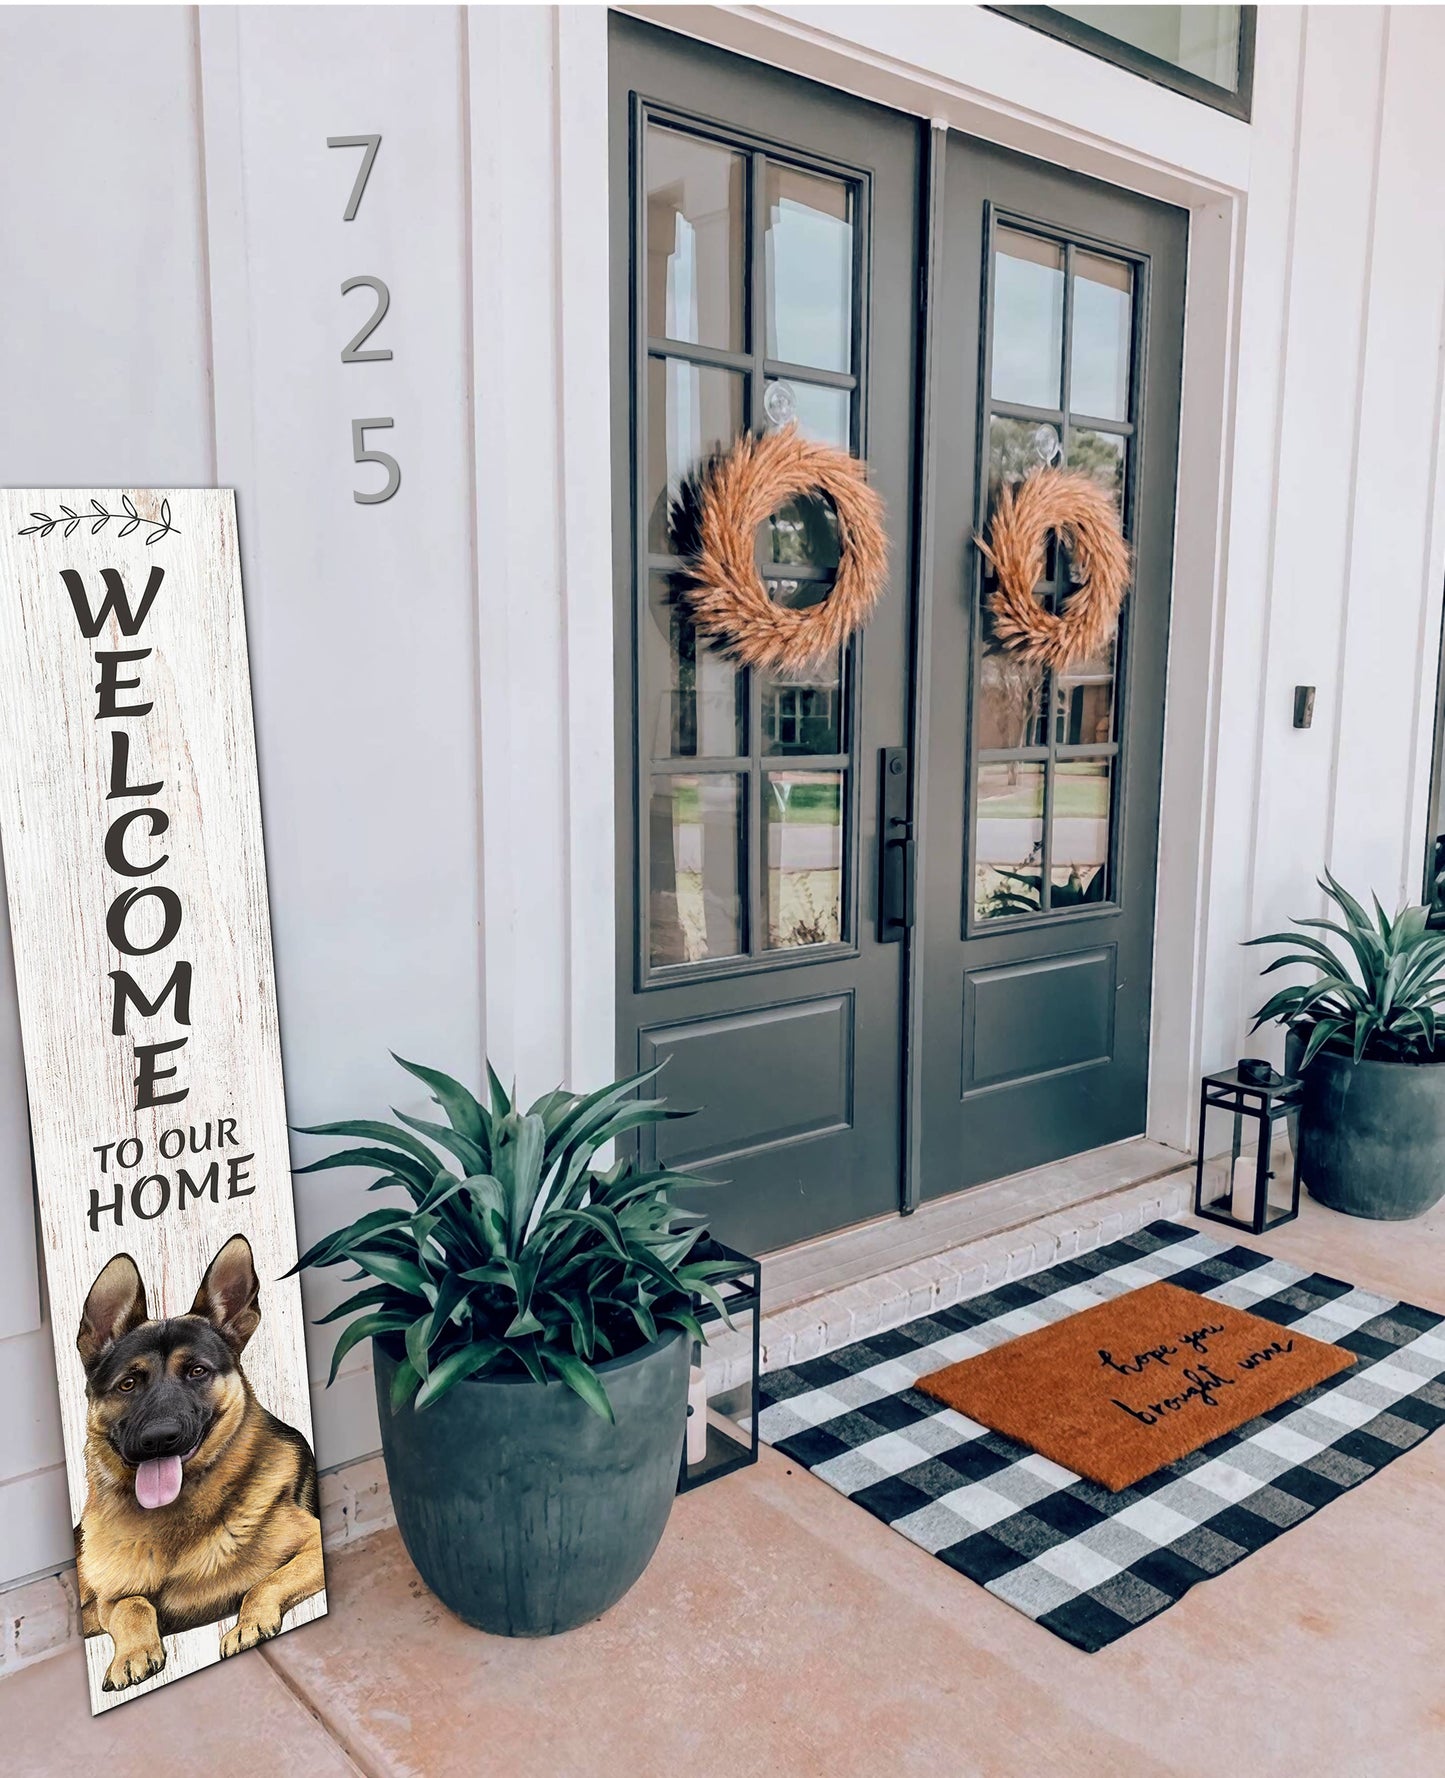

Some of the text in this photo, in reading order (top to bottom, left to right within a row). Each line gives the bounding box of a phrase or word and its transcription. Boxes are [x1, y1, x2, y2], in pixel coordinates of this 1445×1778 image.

[326, 134, 401, 504] 725
[60, 565, 193, 1112] WELCOME
[93, 1119, 239, 1173] TO OUR
[87, 1153, 256, 1232] HOME
[1098, 1325, 1224, 1375] hope you
[1110, 1339, 1293, 1425] brought wine
